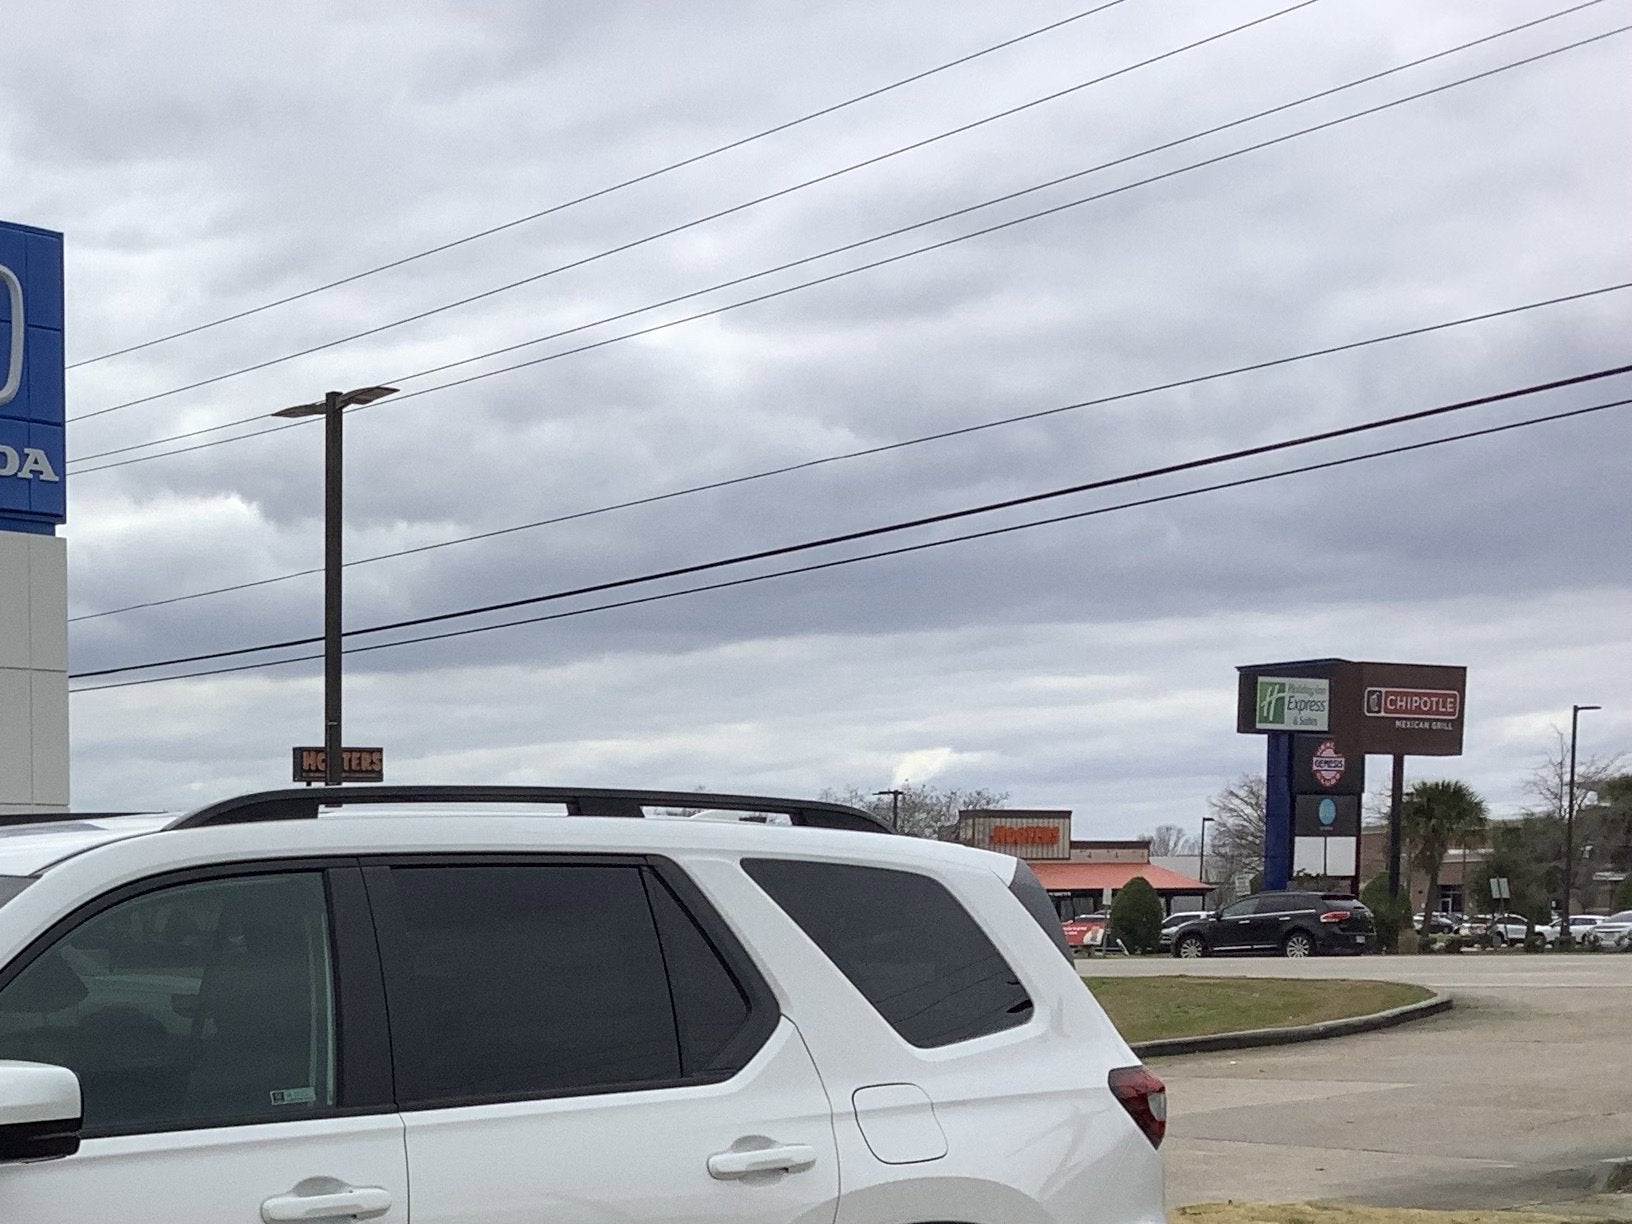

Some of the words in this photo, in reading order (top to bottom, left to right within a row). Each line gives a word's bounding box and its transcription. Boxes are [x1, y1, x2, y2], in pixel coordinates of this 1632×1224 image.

[1287, 695, 1326, 714] Express
[1387, 696, 1454, 712] CHIPOTLE
[1395, 720, 1429, 729] MEXICAN
[1431, 721, 1453, 730] GRILL
[302, 751, 382, 771] HOTERS
